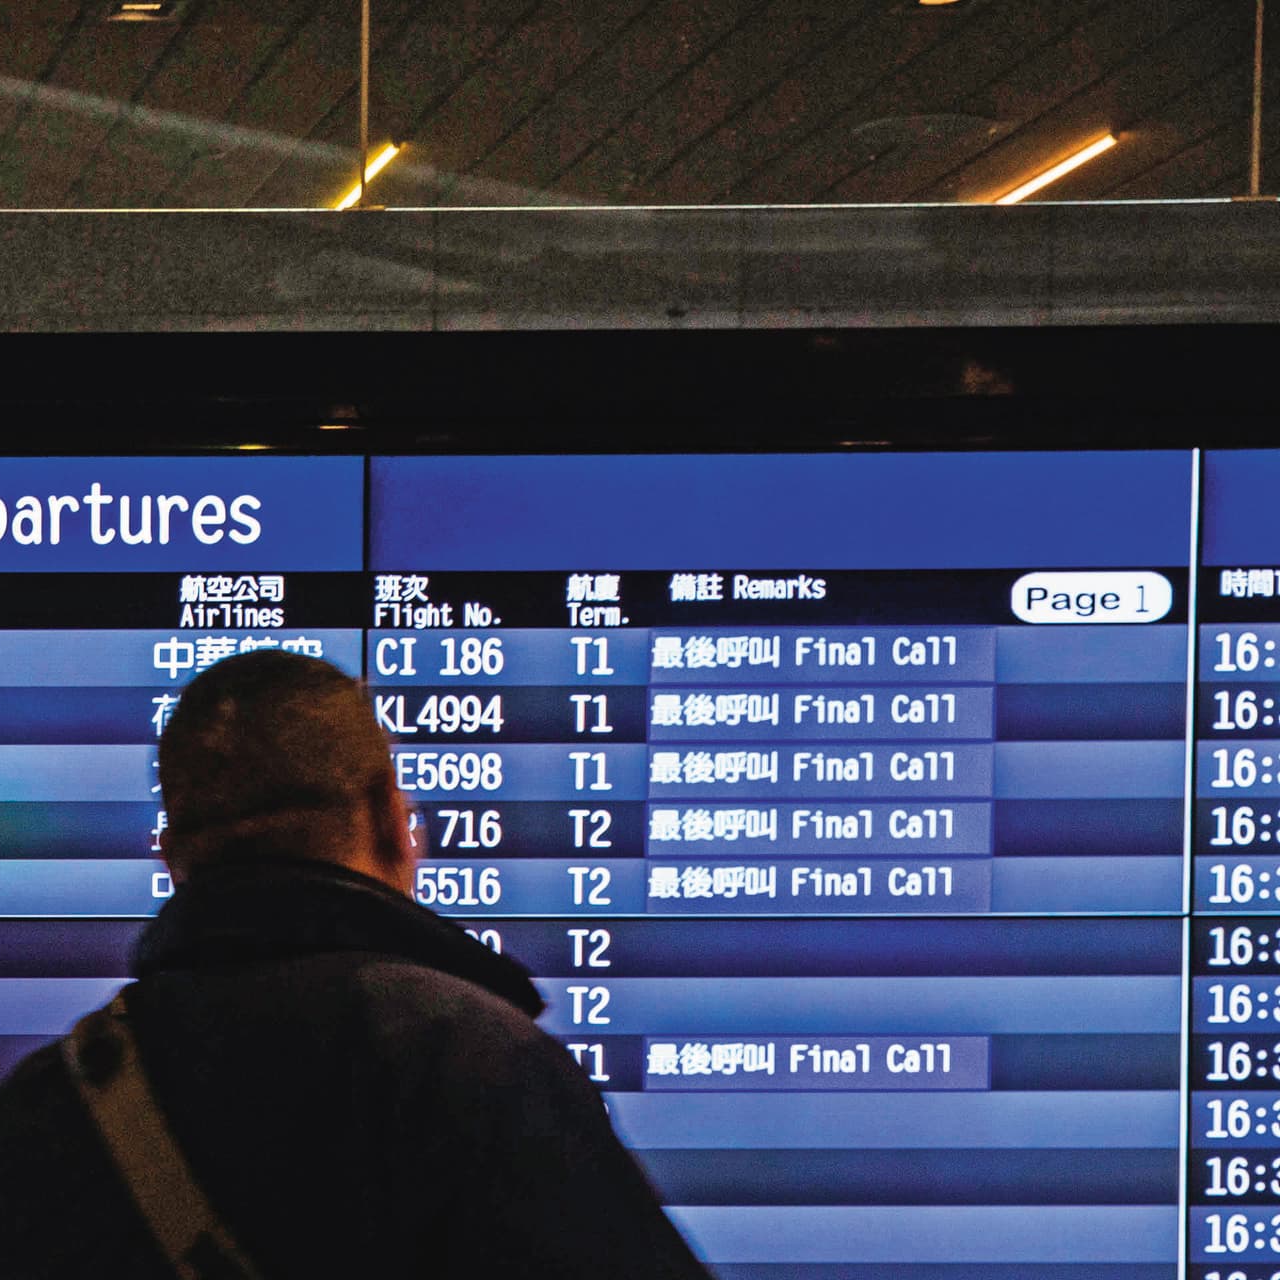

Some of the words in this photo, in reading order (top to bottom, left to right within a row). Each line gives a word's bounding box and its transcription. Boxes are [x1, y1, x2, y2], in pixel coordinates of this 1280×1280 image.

[180, 574, 285, 602] 航空公司
[375, 574, 429, 602] 班次
[669, 573, 724, 601] 備註
[733, 574, 826, 600] Remarks
[1221, 568, 1280, 598] 時間
[1027, 587, 1120, 617] Page
[1135, 583, 1151, 614] 1
[180, 603, 285, 628] Airlines
[375, 602, 454, 629] Flight
[464, 602, 502, 627] No.
[567, 602, 630, 627] Term.
[376, 637, 417, 676] CI
[439, 637, 504, 676] 186
[570, 636, 614, 675] T1
[651, 635, 780, 669] 最後呼叫
[795, 636, 875, 666] Final
[892, 636, 956, 666] Call
[375, 694, 505, 733] KL4994
[646, 1042, 775, 1075] 最後呼叫
[789, 1043, 870, 1073] Final
[886, 1043, 951, 1073] Call
